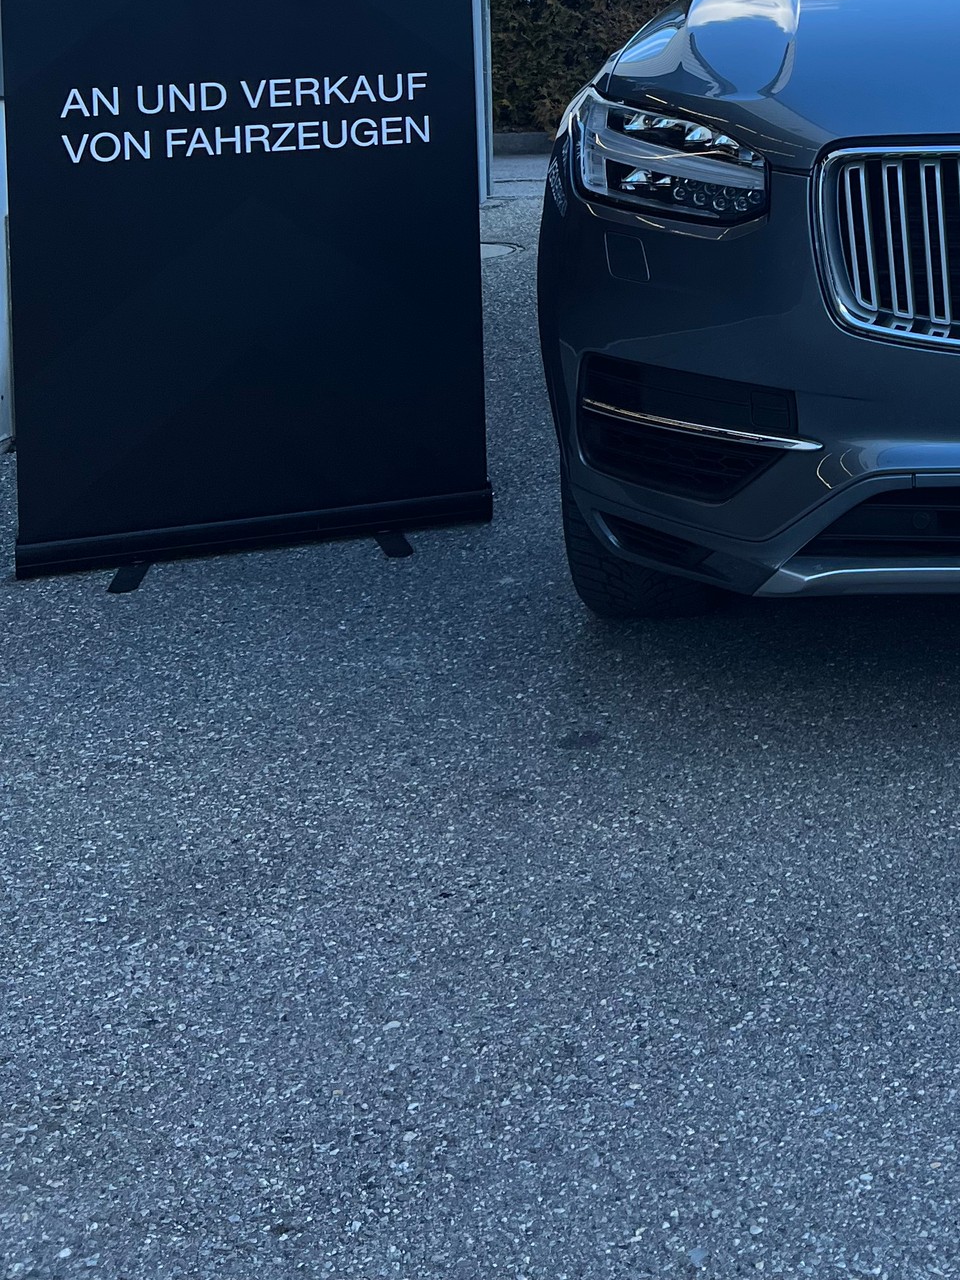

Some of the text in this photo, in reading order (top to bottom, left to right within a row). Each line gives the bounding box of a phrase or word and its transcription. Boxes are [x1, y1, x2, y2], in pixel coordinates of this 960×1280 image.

[60, 72, 428, 118] AN UND VERKAUF
[61, 115, 430, 163] VON FAHRZEUGEN
